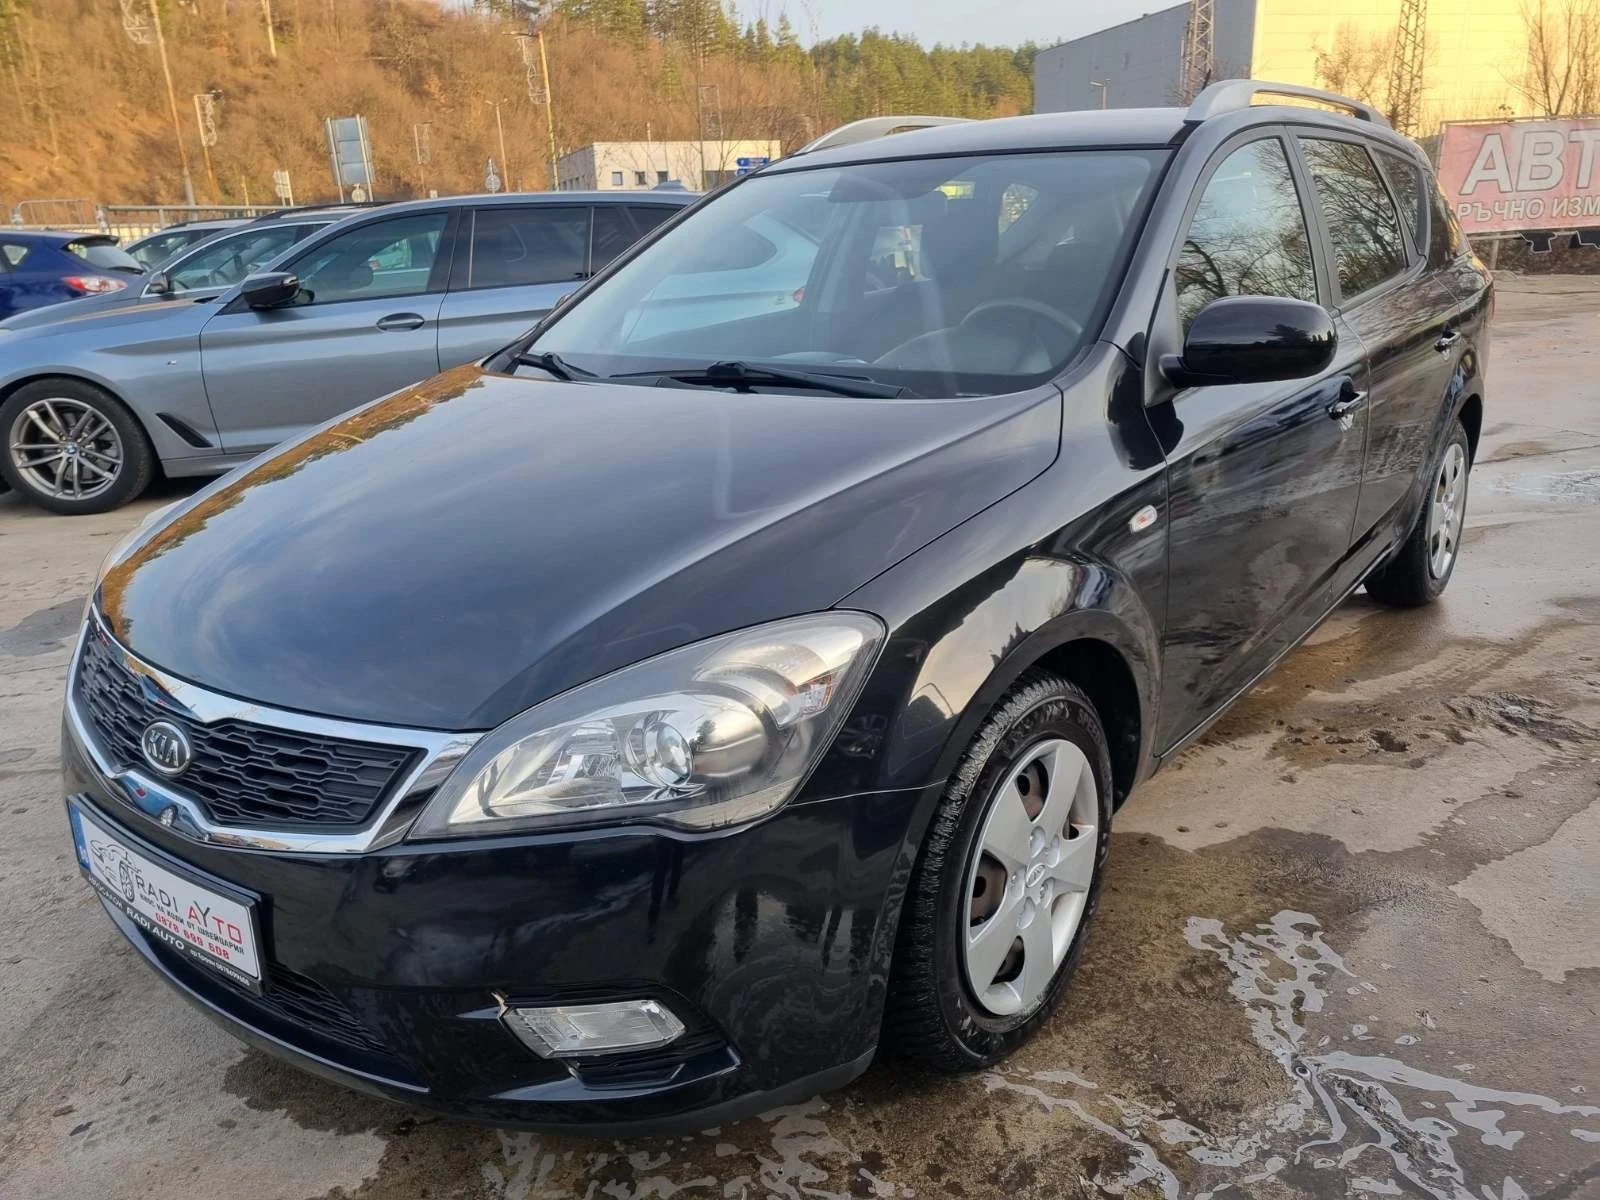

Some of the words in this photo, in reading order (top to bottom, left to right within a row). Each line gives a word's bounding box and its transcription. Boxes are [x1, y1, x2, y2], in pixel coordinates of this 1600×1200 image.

[1456, 197, 1546, 222] РЪЧНО
[136, 874, 178, 913] RADI
[126, 906, 151, 930] RADI
[152, 926, 186, 950] AUTO
